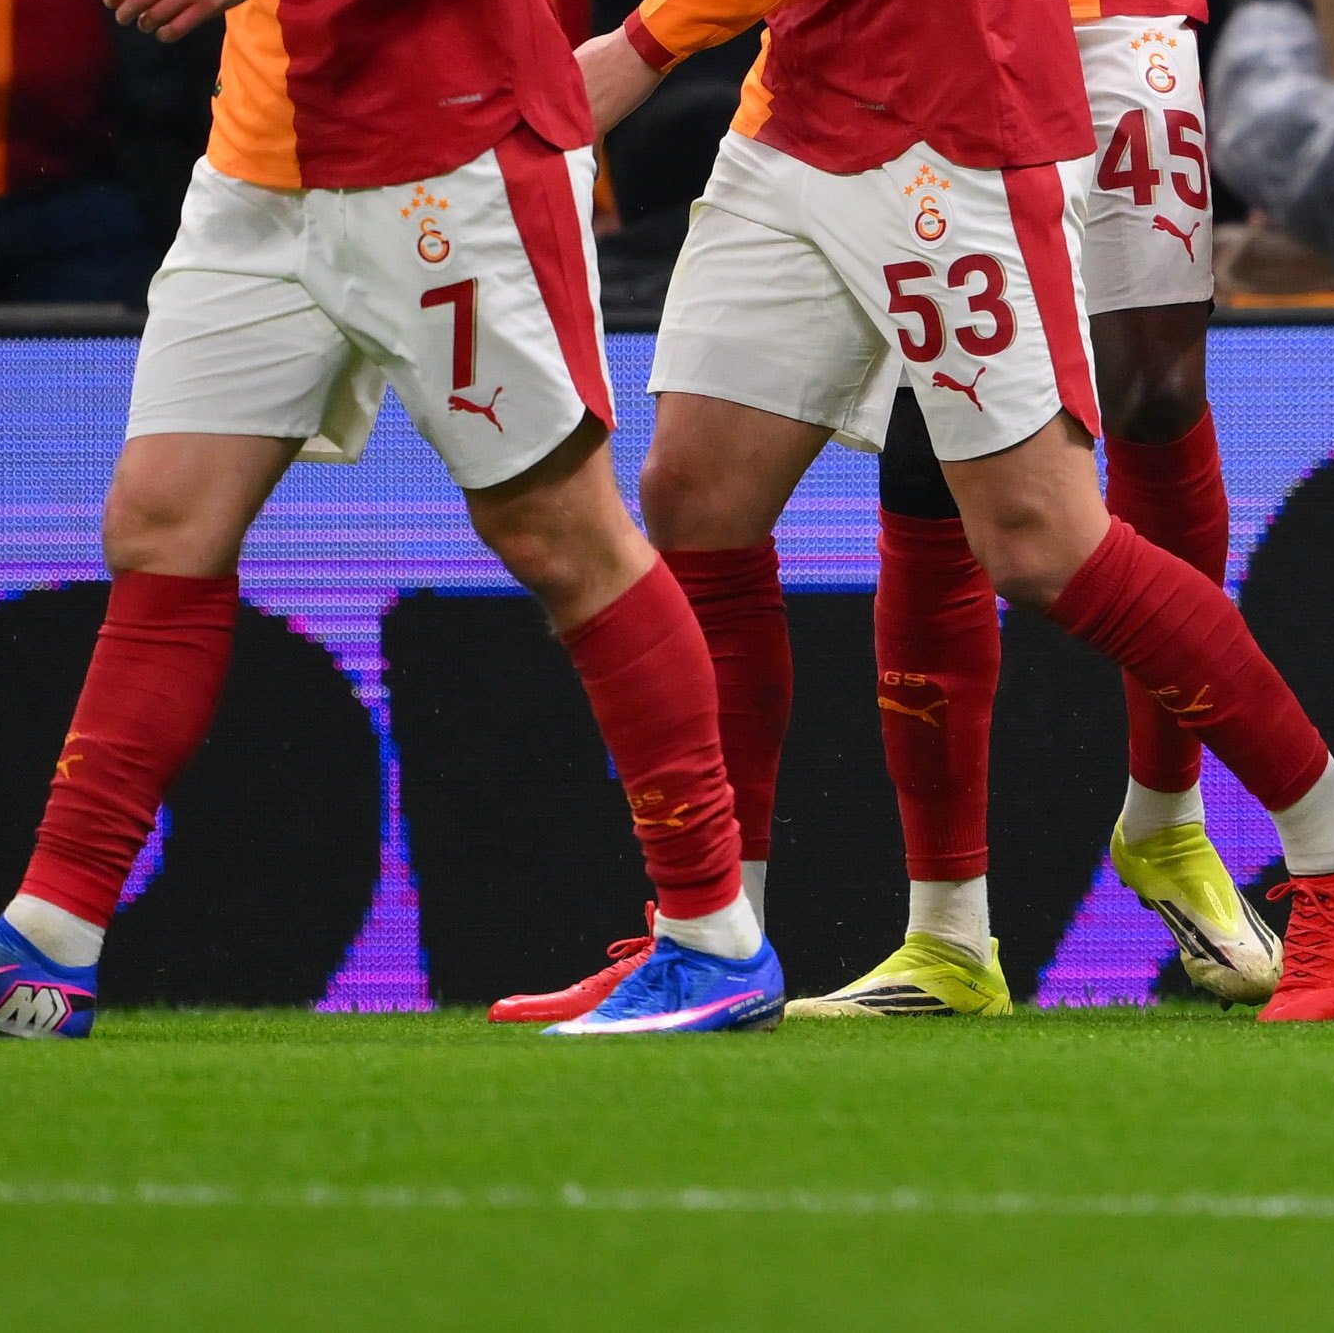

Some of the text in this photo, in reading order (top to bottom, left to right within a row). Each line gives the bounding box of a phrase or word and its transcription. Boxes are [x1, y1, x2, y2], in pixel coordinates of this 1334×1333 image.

[1097, 108, 1209, 212] 45
[420, 277, 479, 391] 7
[883, 253, 1019, 364] 53
[884, 671, 926, 688] GS
